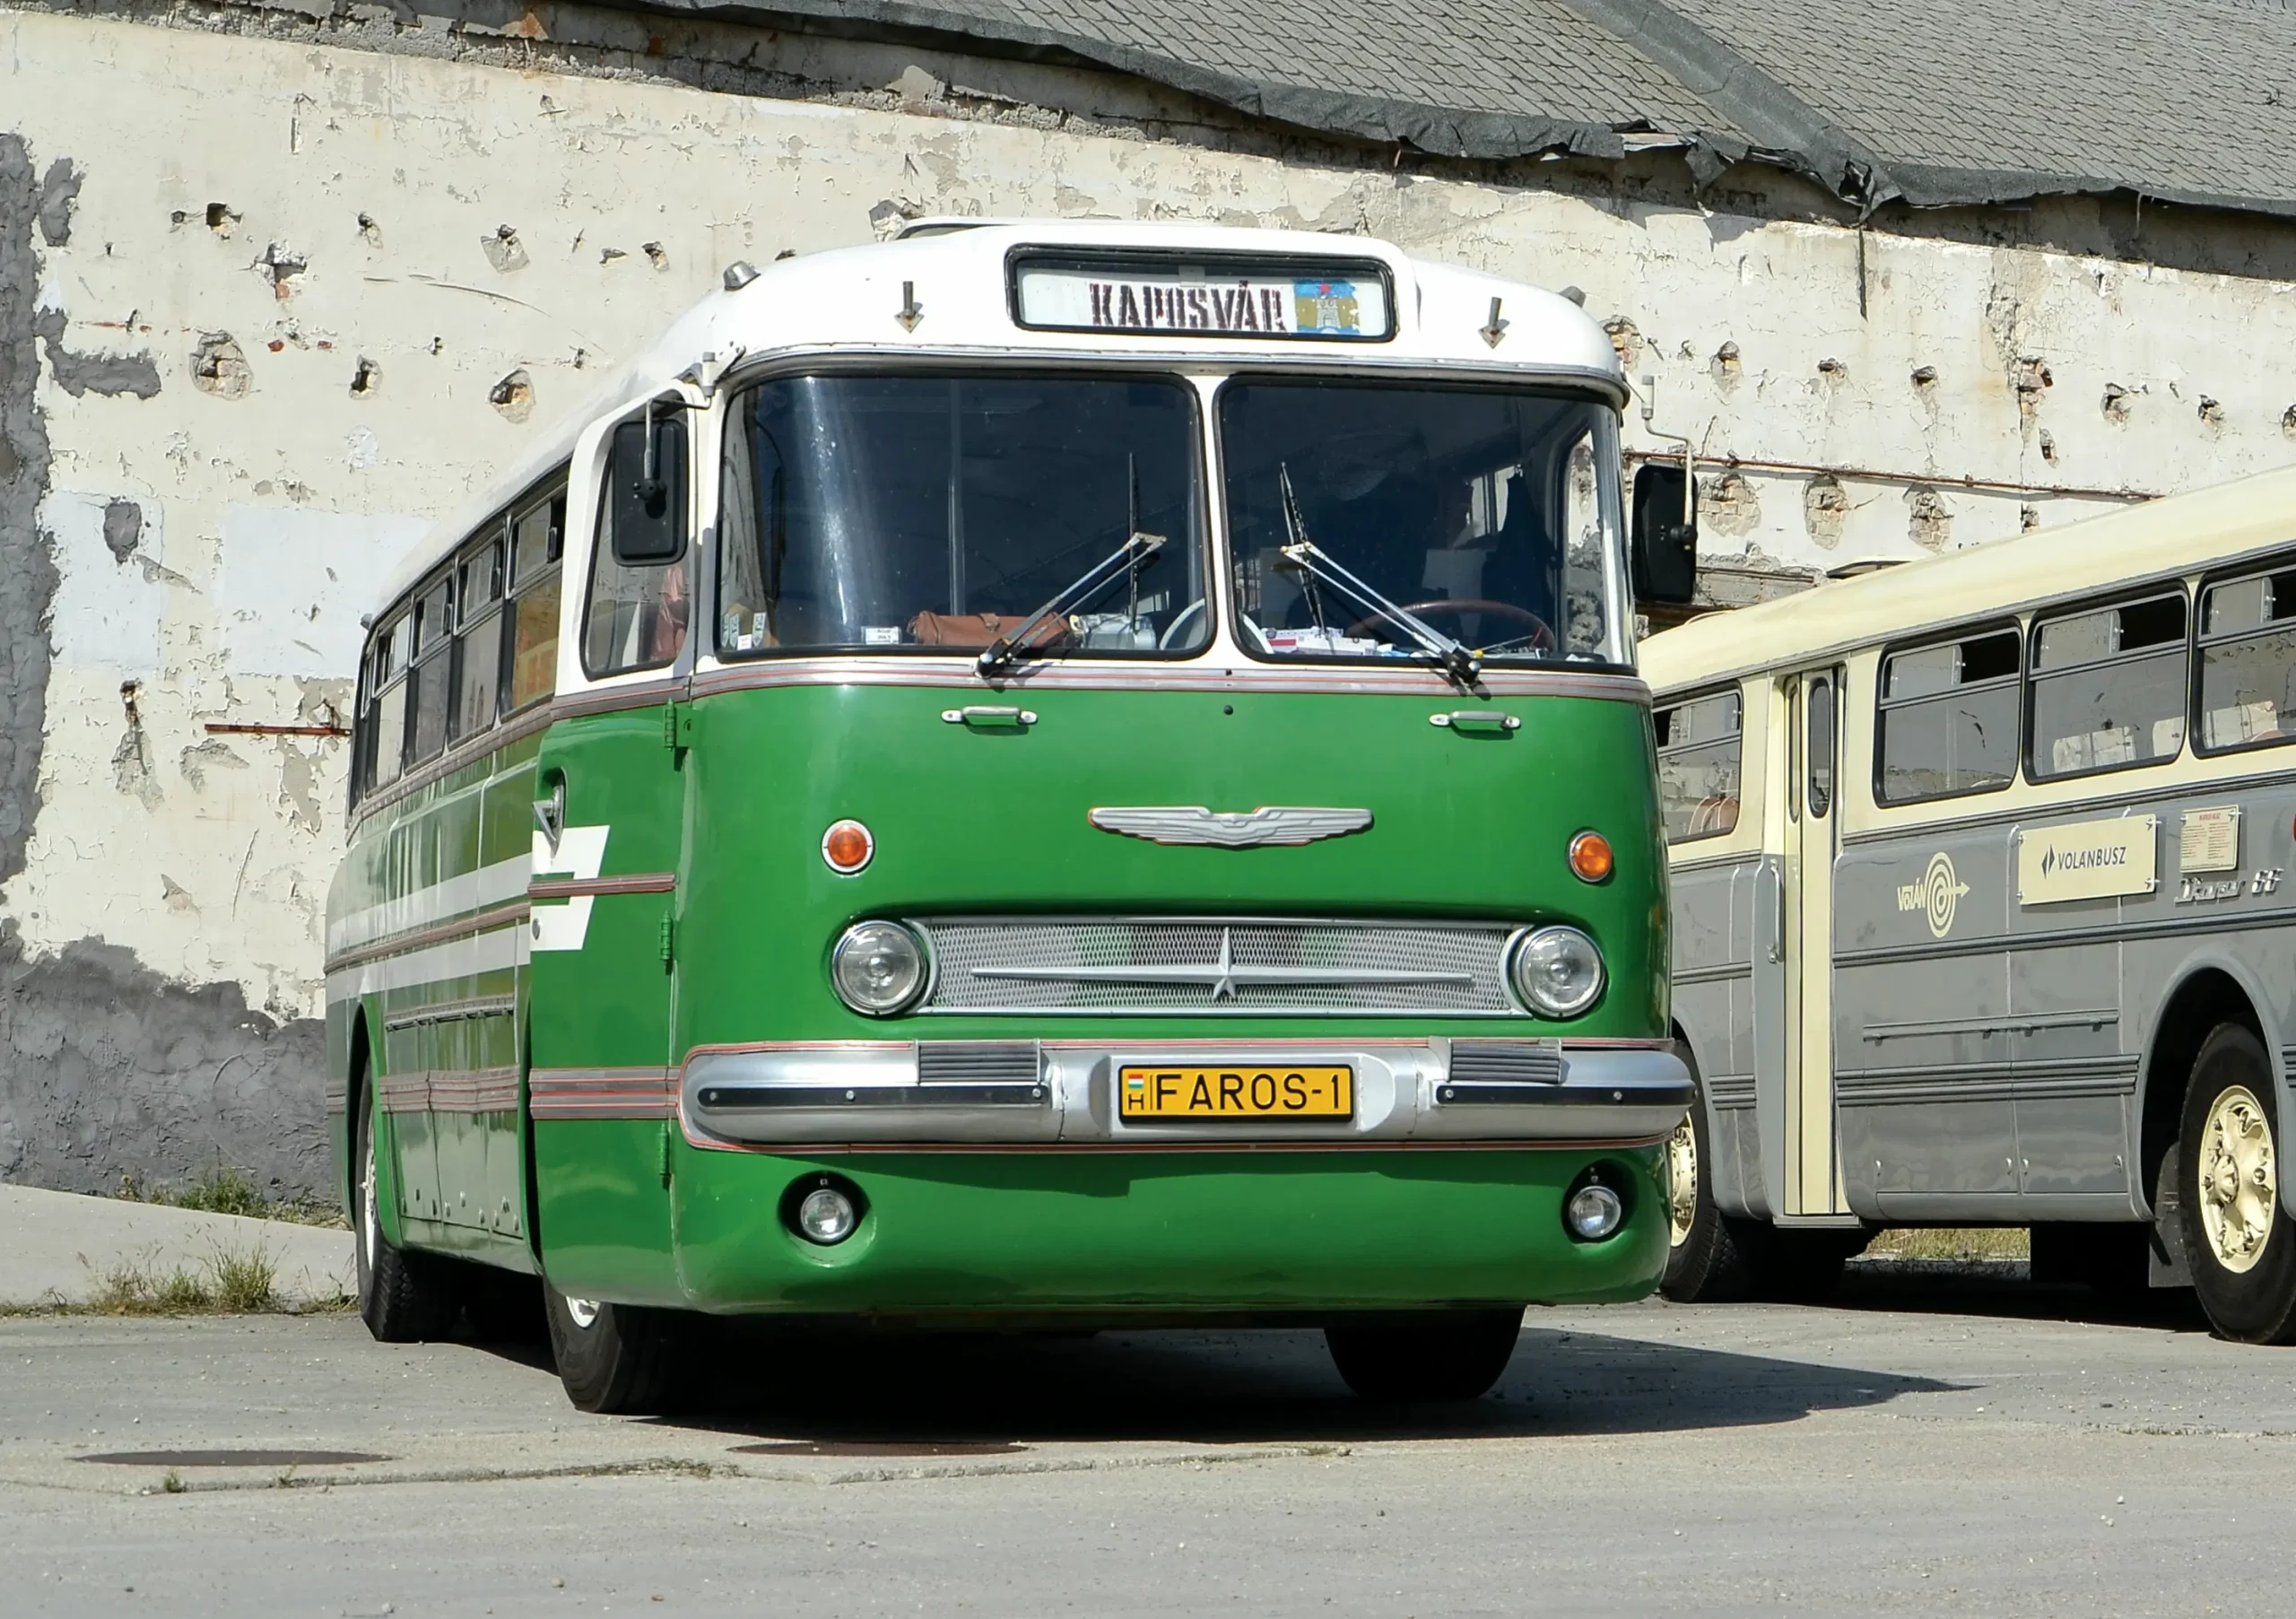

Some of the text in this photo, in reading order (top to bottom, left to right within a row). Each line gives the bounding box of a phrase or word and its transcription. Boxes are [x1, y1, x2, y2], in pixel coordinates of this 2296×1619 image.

[1089, 280, 1287, 331] KAPOSVÁR
[1128, 1073, 1339, 1110] H FAROS-1
